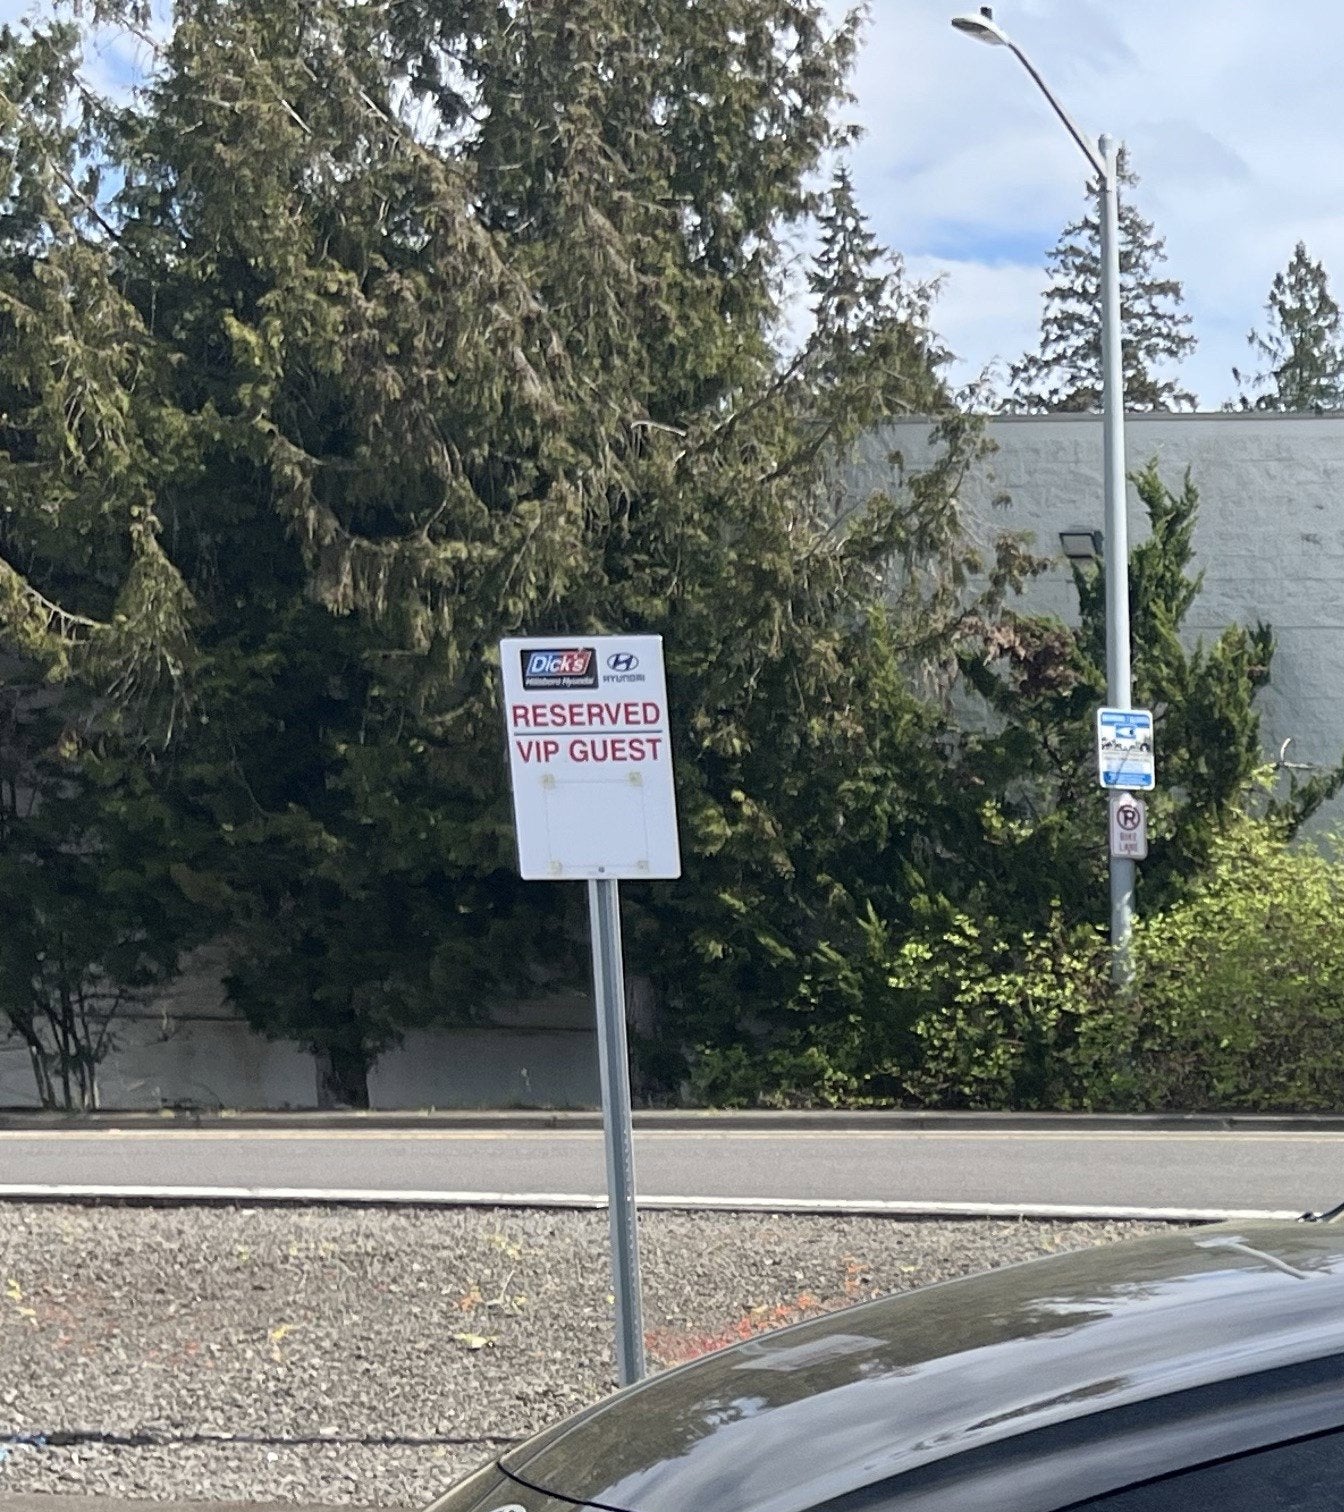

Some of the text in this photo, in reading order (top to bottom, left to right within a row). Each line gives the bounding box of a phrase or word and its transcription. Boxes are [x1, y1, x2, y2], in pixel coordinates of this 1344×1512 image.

[531, 653, 585, 673] Dick's
[602, 674, 646, 684] HYUNDAI
[512, 702, 661, 728] RESERVED
[516, 737, 663, 763] VIP GUEST
